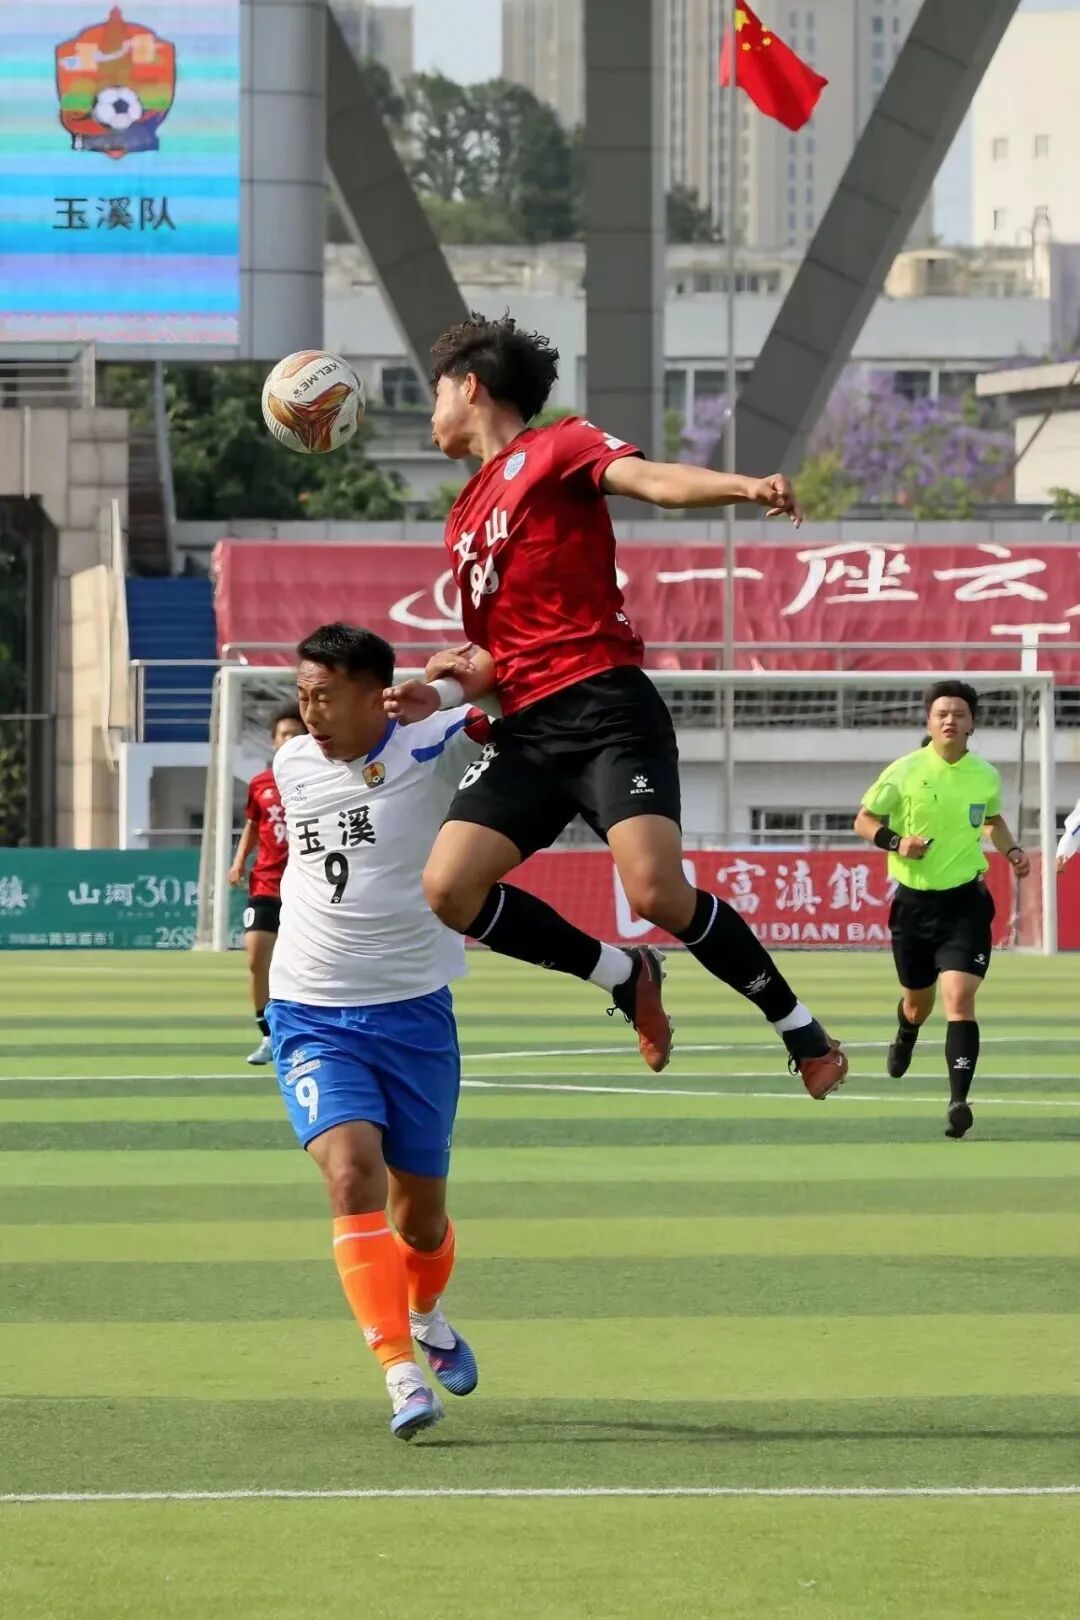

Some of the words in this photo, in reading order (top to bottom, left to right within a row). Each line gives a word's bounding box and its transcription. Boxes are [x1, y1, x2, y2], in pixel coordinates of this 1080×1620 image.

[52, 196, 177, 231] 玉溪队
[302, 362, 340, 392] KELME
[452, 506, 509, 575] 文山
[656, 543, 1080, 617] 一座云
[295, 805, 377, 856] 玉溪
[324, 852, 350, 904] 9
[750, 922, 840, 941] UDIAN
[295, 1076, 319, 1125] 9
